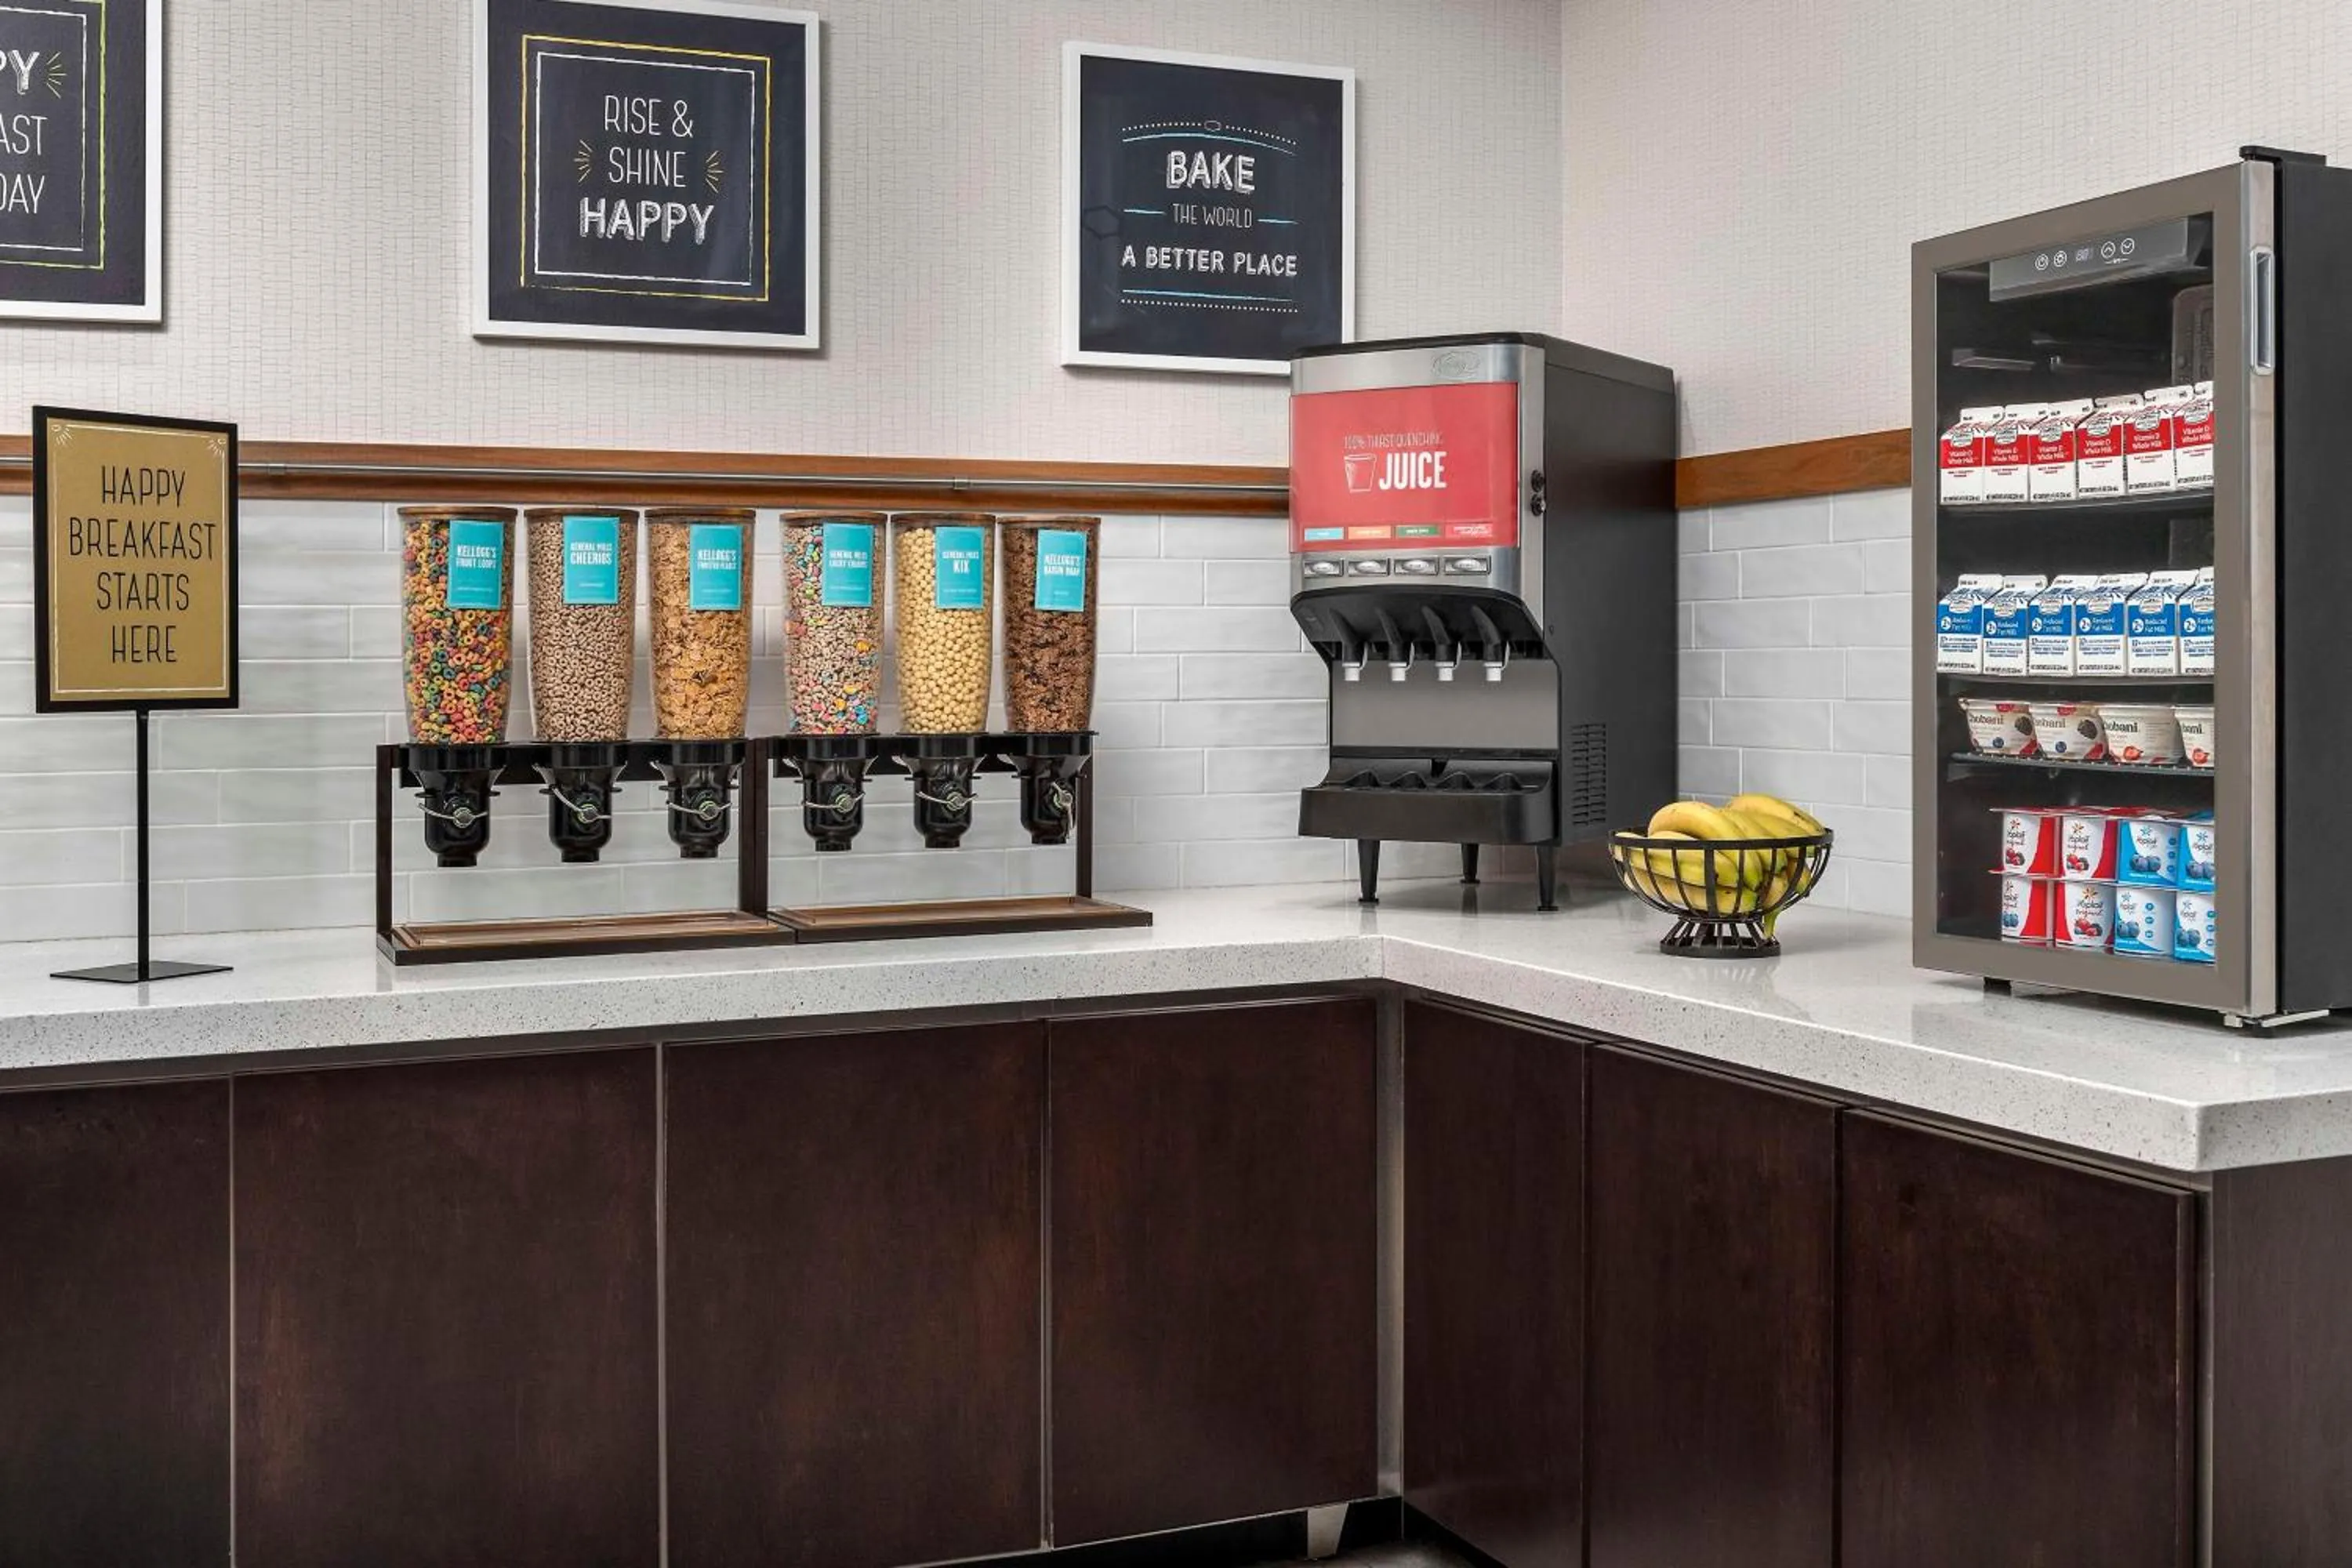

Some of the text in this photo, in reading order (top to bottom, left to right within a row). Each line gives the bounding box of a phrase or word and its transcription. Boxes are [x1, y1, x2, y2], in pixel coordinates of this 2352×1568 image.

[604, 95, 693, 138] RISE &
[608, 147, 686, 187] SHINE
[1166, 151, 1256, 195] BAKE
[579, 197, 714, 245] HAPPY
[1172, 203, 1253, 228] THE WORLD
[1122, 245, 1298, 276] A BETTER PLACE
[102, 466, 185, 508] HAPPY
[1379, 451, 1447, 490] JUICE
[69, 517, 216, 560] BREAKFAST
[570, 551, 612, 565] CHEERIOS
[953, 560, 970, 574] KIX
[97, 572, 190, 612] STARTS
[112, 625, 177, 664] HERE
[2182, 723, 2202, 734] bani
